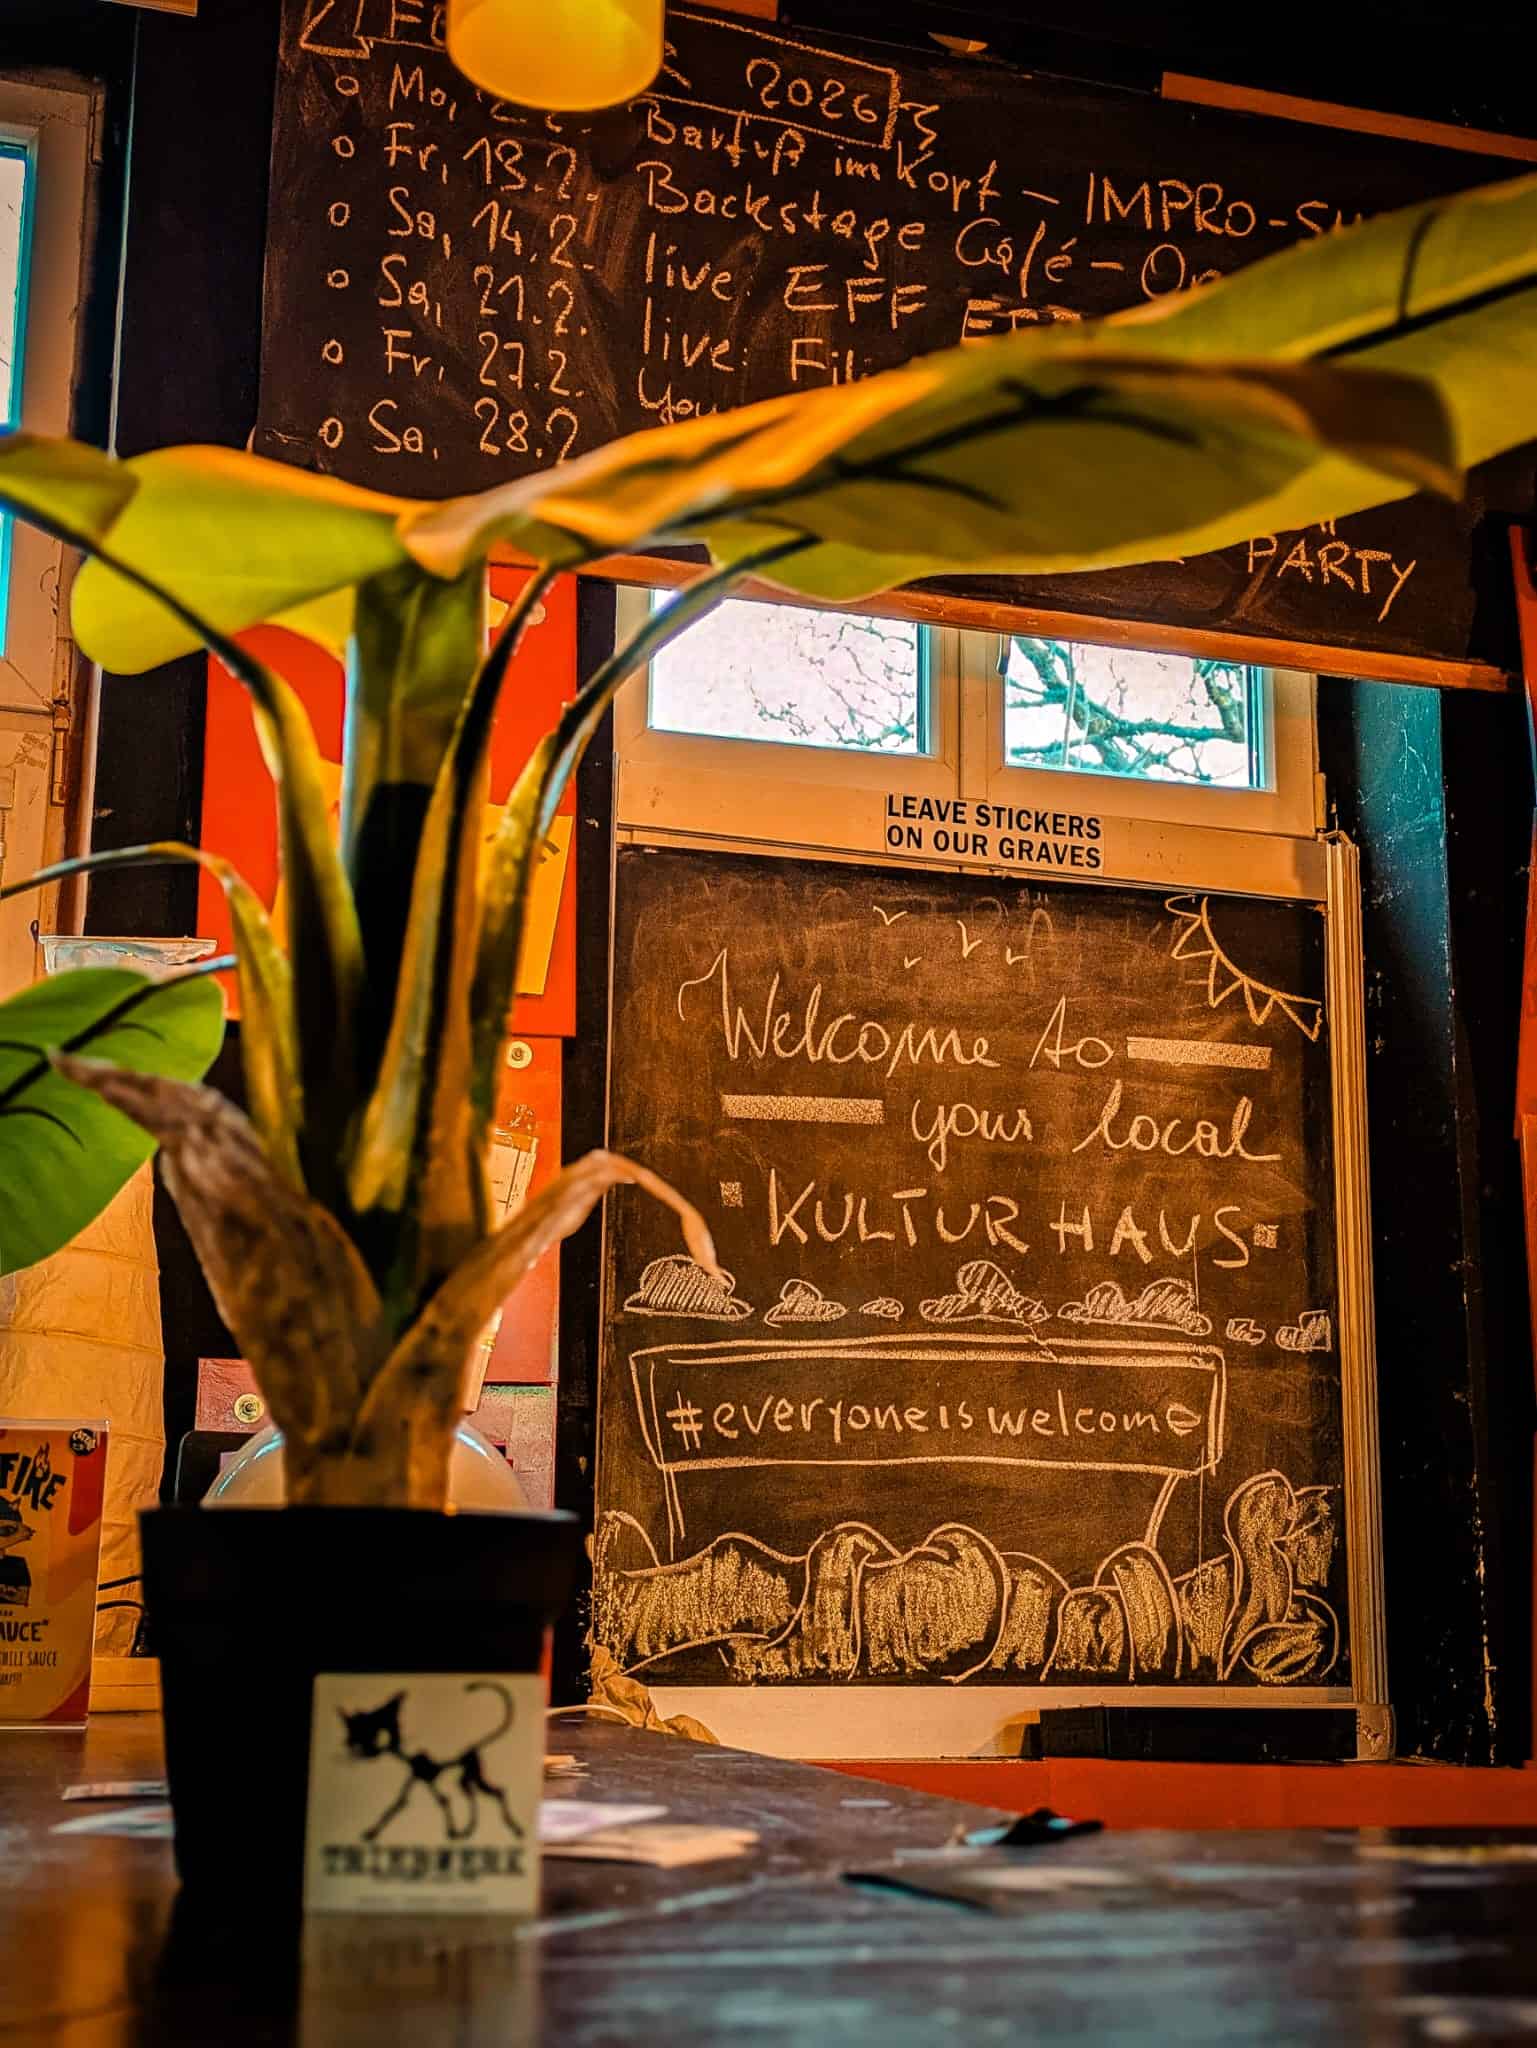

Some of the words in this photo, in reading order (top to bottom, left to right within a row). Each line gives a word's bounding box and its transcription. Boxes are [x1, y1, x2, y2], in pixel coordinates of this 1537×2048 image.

[746, 57, 878, 122] 2026
[384, 122, 448, 184] Fr,
[636, 161, 925, 270] Backstage
[388, 186, 451, 261] Sa,
[383, 328, 445, 381] Fr,
[1247, 535, 1417, 623] PARTY
[886, 824, 923, 849] ON
[933, 829, 989, 856] OUR
[998, 836, 1102, 869] GRAVES
[887, 794, 968, 825] LEAVE
[975, 803, 1102, 841] STICKERS
[678, 947, 1002, 1079] Welcome
[1028, 996, 1115, 1069] to
[911, 1097, 1034, 1172] your
[1072, 1078, 1282, 1161] local
